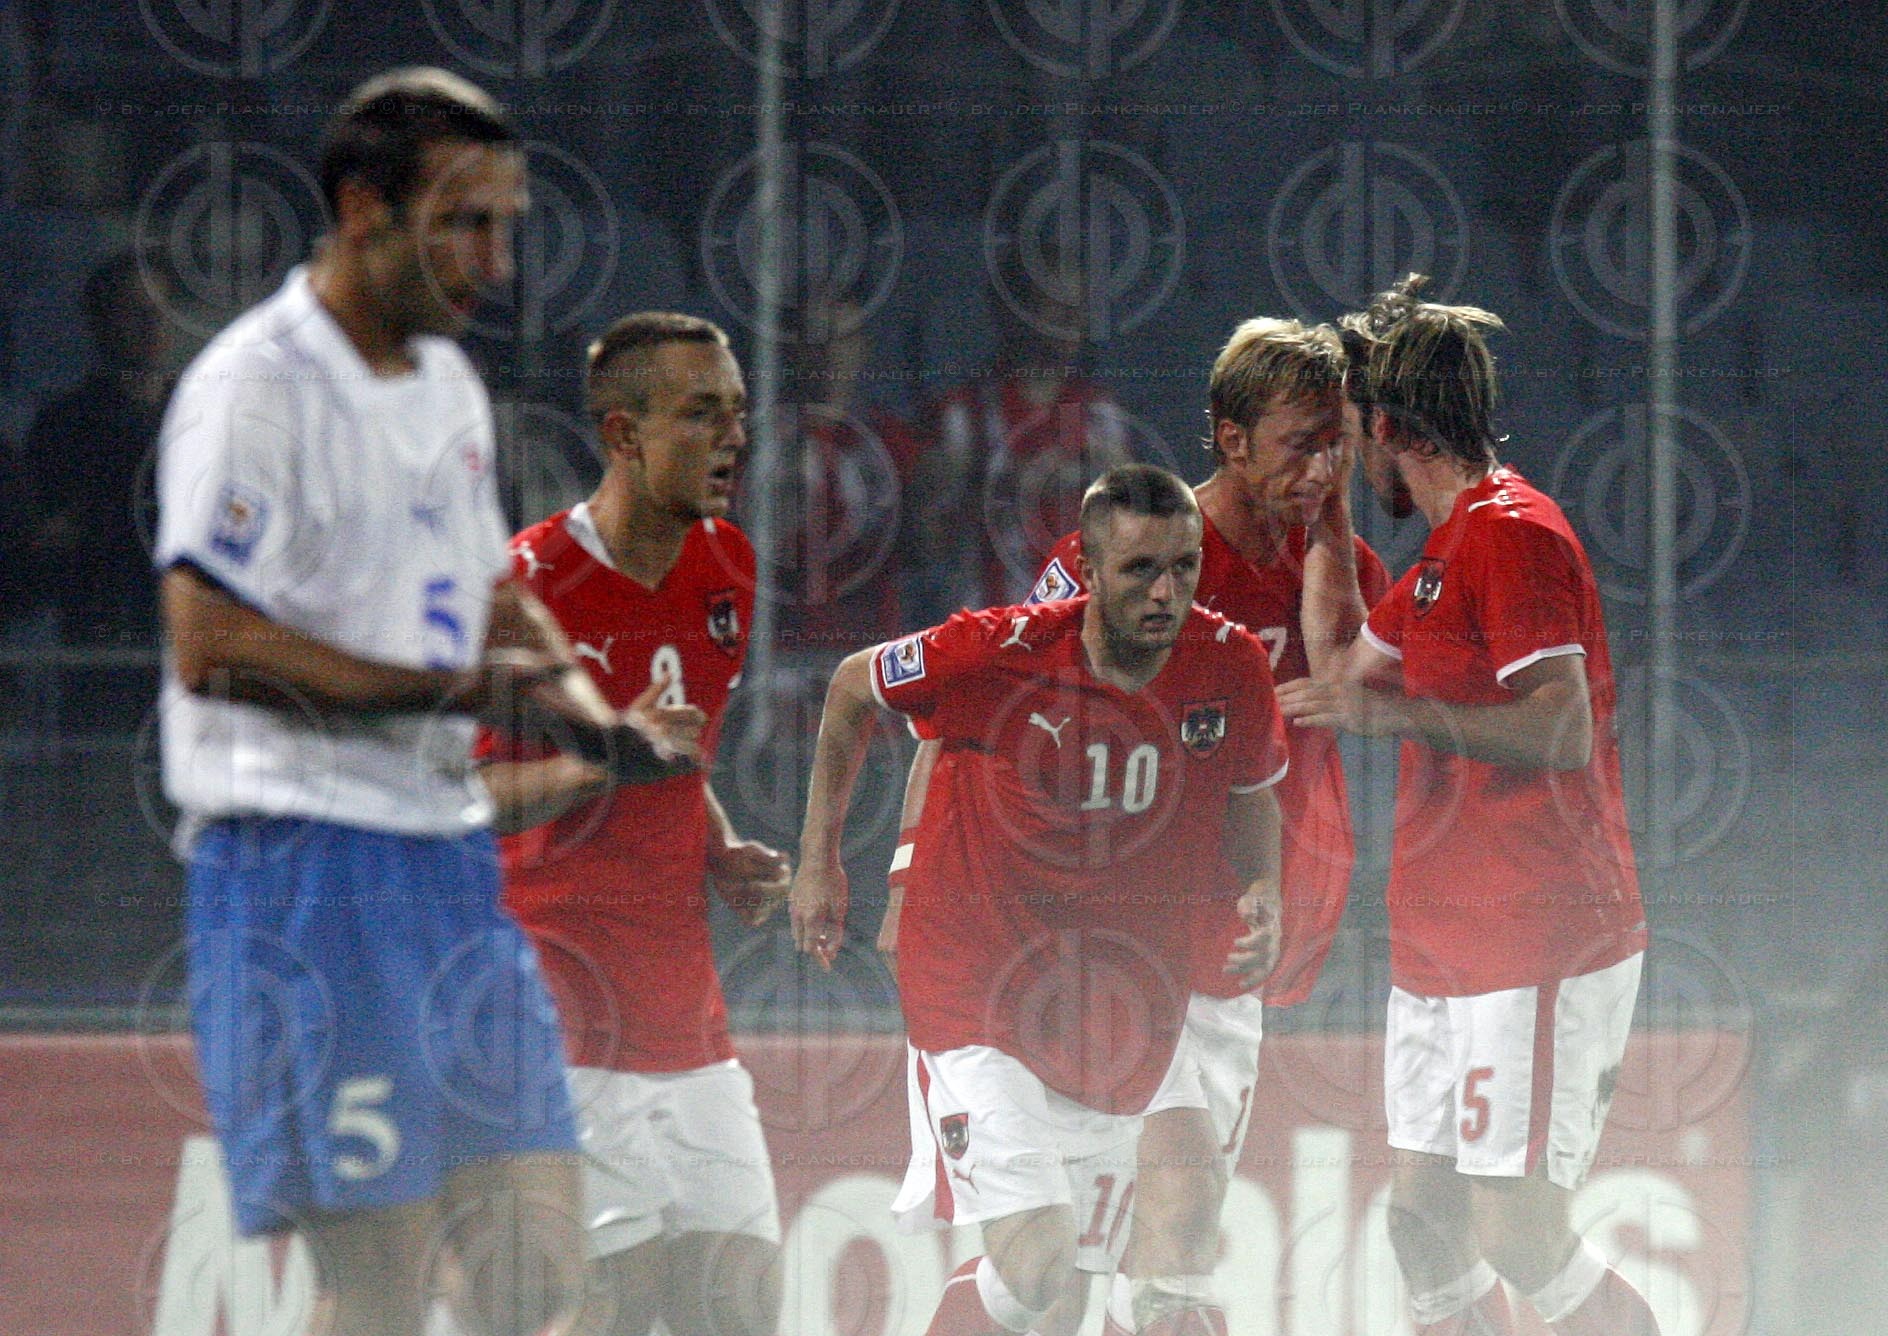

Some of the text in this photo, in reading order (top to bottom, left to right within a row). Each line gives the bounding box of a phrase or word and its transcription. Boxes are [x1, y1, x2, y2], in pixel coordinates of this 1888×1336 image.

[1080, 743, 1159, 814] 10
[330, 1074, 401, 1181] 5
[1460, 1065, 1496, 1142] 5
